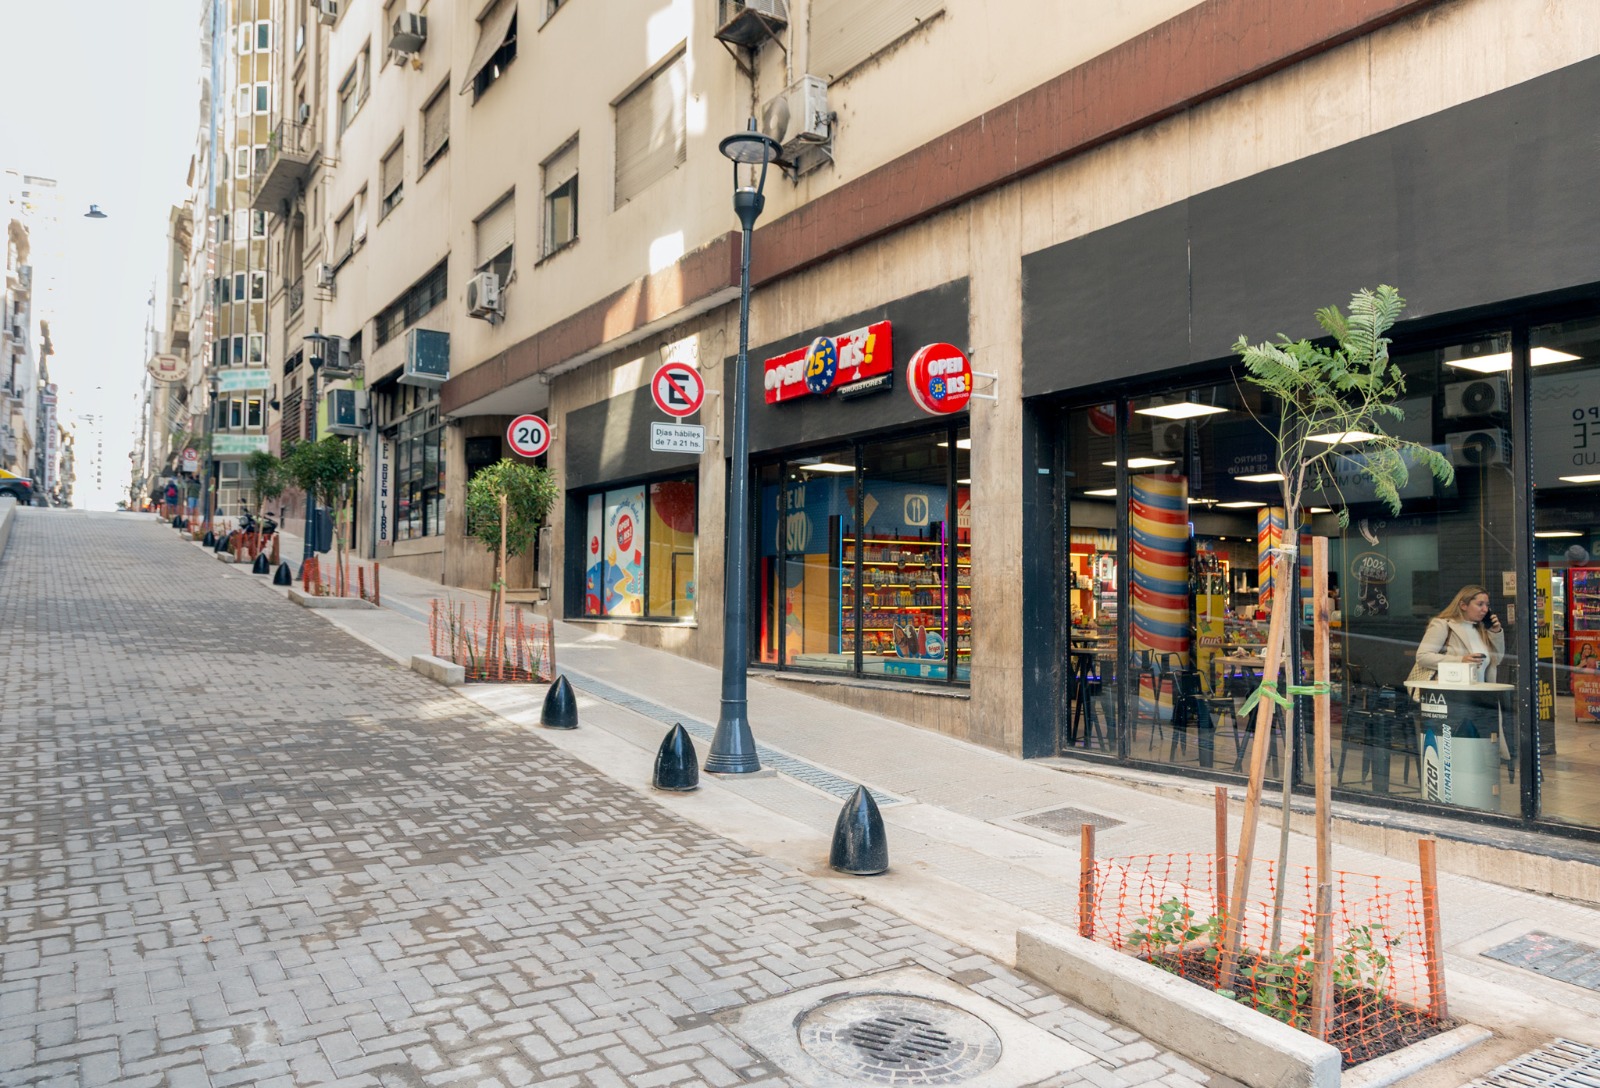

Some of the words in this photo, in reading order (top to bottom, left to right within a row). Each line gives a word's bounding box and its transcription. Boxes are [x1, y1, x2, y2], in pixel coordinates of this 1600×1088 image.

[764, 359, 805, 391] OPEN
[807, 350, 826, 377] 25
[927, 356, 963, 376] OPEN
[841, 377, 883, 394] DRUGSTORES
[517, 426, 542, 445] 20
[655, 438, 665, 446] de
[667, 438, 671, 446] 7
[679, 439, 688, 447] 21
[382, 442, 389, 460] EL
[381, 463, 389, 497] BUEN
[380, 500, 388, 540] LIBRO
[1362, 557, 1386, 571] 100%
[1429, 692, 1447, 705] AA
[1442, 723, 1452, 760] LITHIUM
